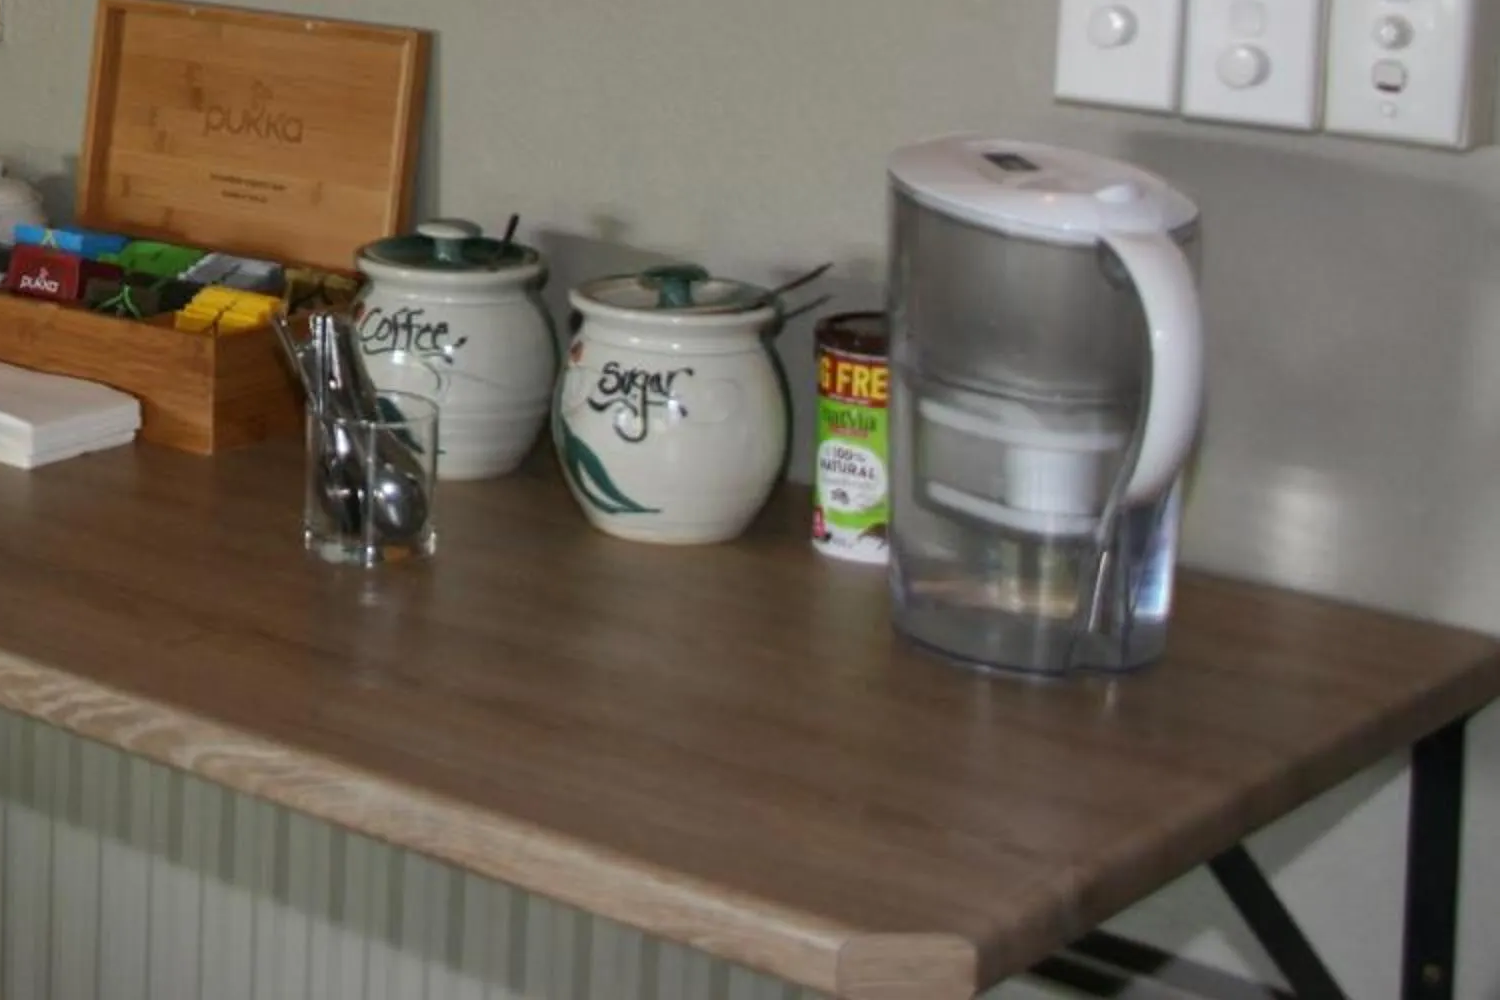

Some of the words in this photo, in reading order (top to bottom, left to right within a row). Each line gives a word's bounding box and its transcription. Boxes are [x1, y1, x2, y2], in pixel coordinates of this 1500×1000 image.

[202, 104, 304, 144] pukka
[358, 306, 457, 363] Coffee
[595, 360, 696, 443] Sugar
[836, 361, 889, 400] FRE
